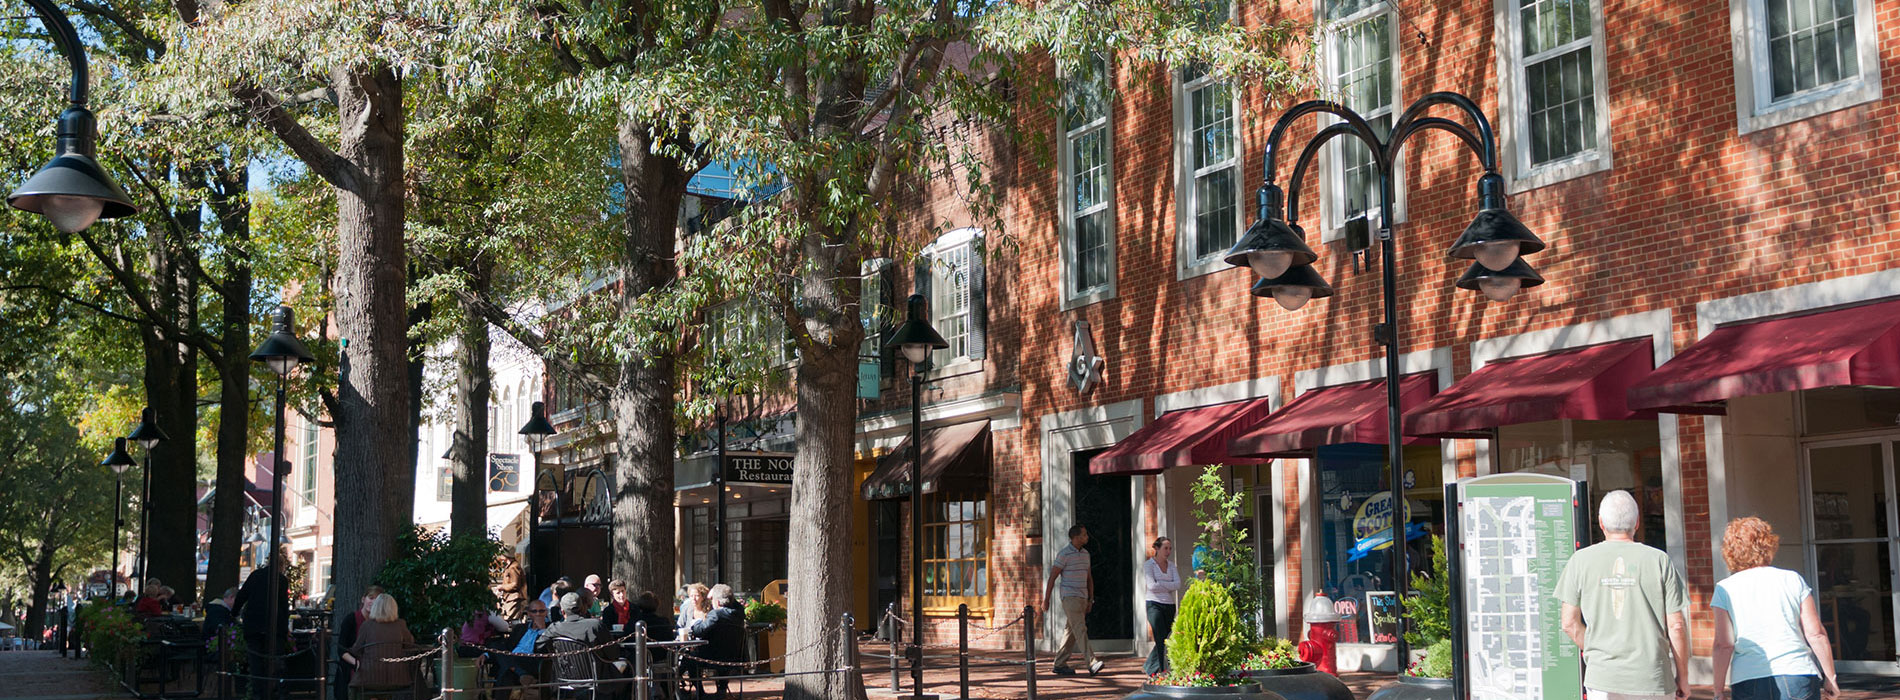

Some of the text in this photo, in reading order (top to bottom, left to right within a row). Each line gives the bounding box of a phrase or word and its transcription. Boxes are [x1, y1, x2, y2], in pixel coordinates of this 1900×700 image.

[490, 454, 519, 465] Spectacle
[732, 458, 795, 470] THE NO
[739, 470, 793, 481] Restaura
[1365, 497, 1392, 518] GREA
[1334, 601, 1357, 614] OPEN
